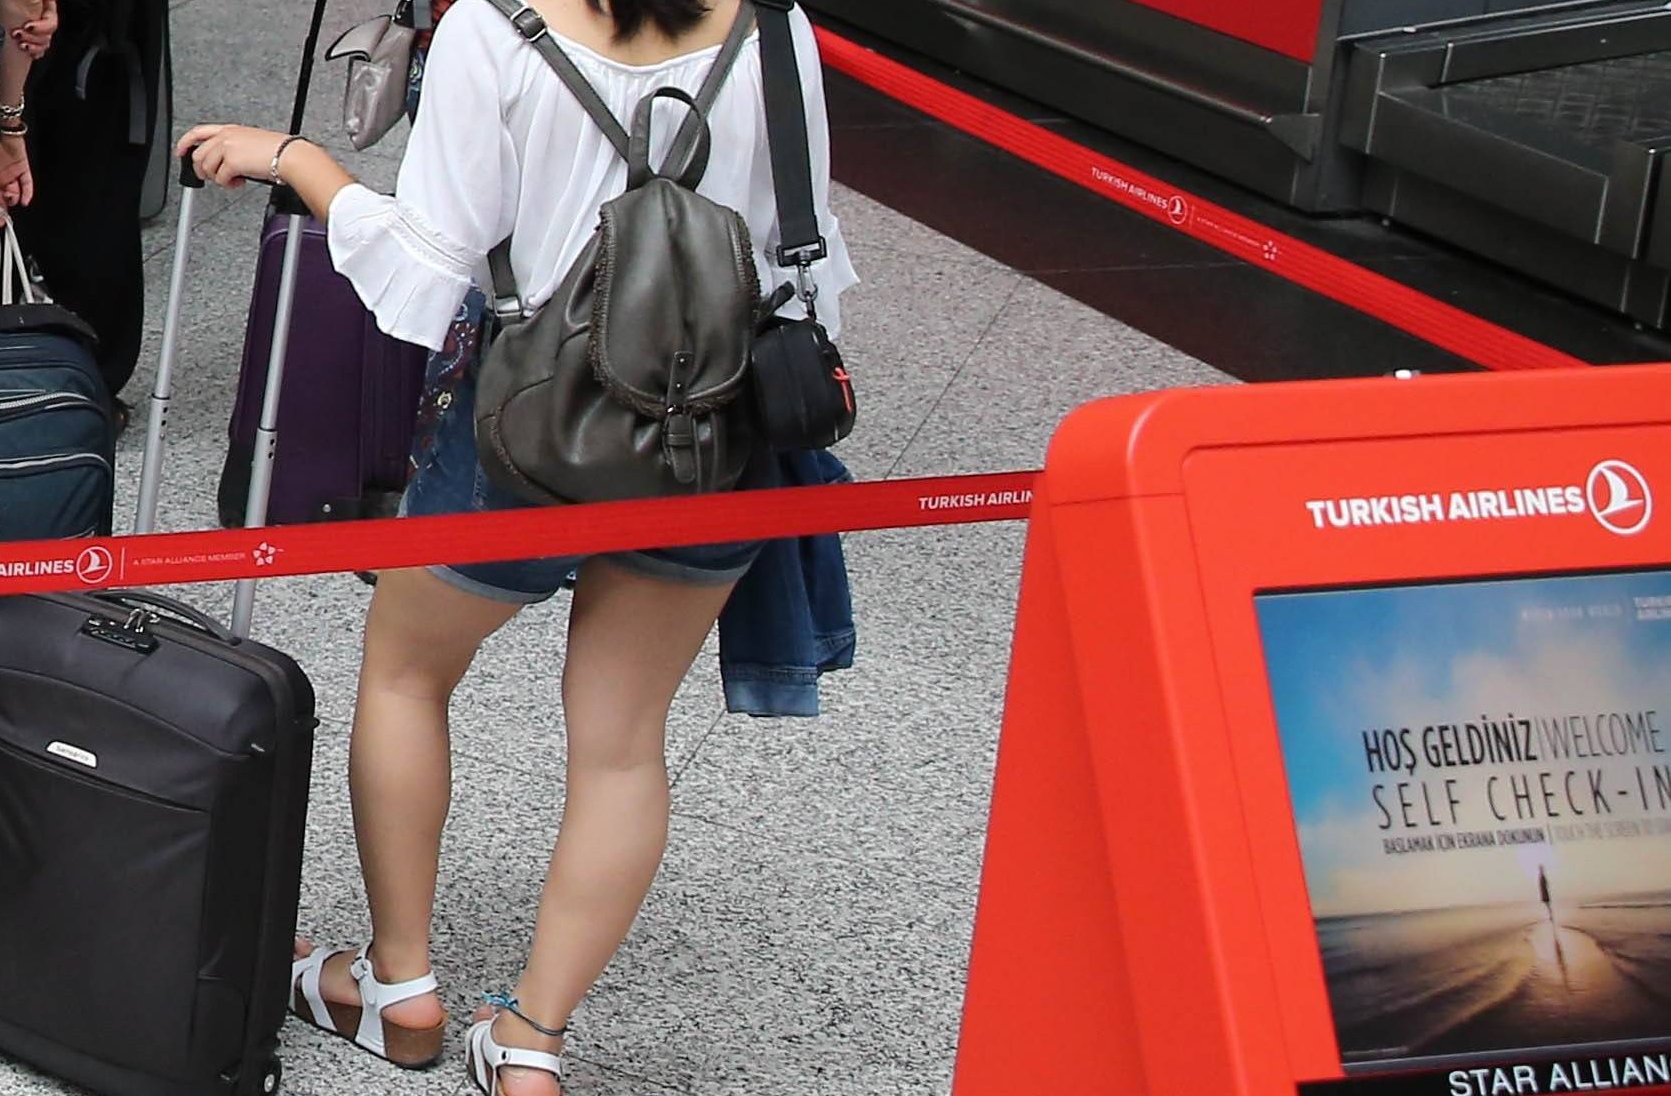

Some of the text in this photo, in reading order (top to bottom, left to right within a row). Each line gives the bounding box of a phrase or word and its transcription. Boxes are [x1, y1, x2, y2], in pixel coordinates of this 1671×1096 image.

[1090, 167, 1168, 210] TURKISH AIRLINES
[918, 492, 985, 510] TURKISH
[1306, 486, 1585, 528] TURKISH AIRLINES
[1362, 710, 1666, 776] HOŞ GELDİNİZ WELCOME
[1372, 764, 1671, 830] SELF CHECK-IN
[1448, 1054, 1671, 1096] STAR ALLIAN
